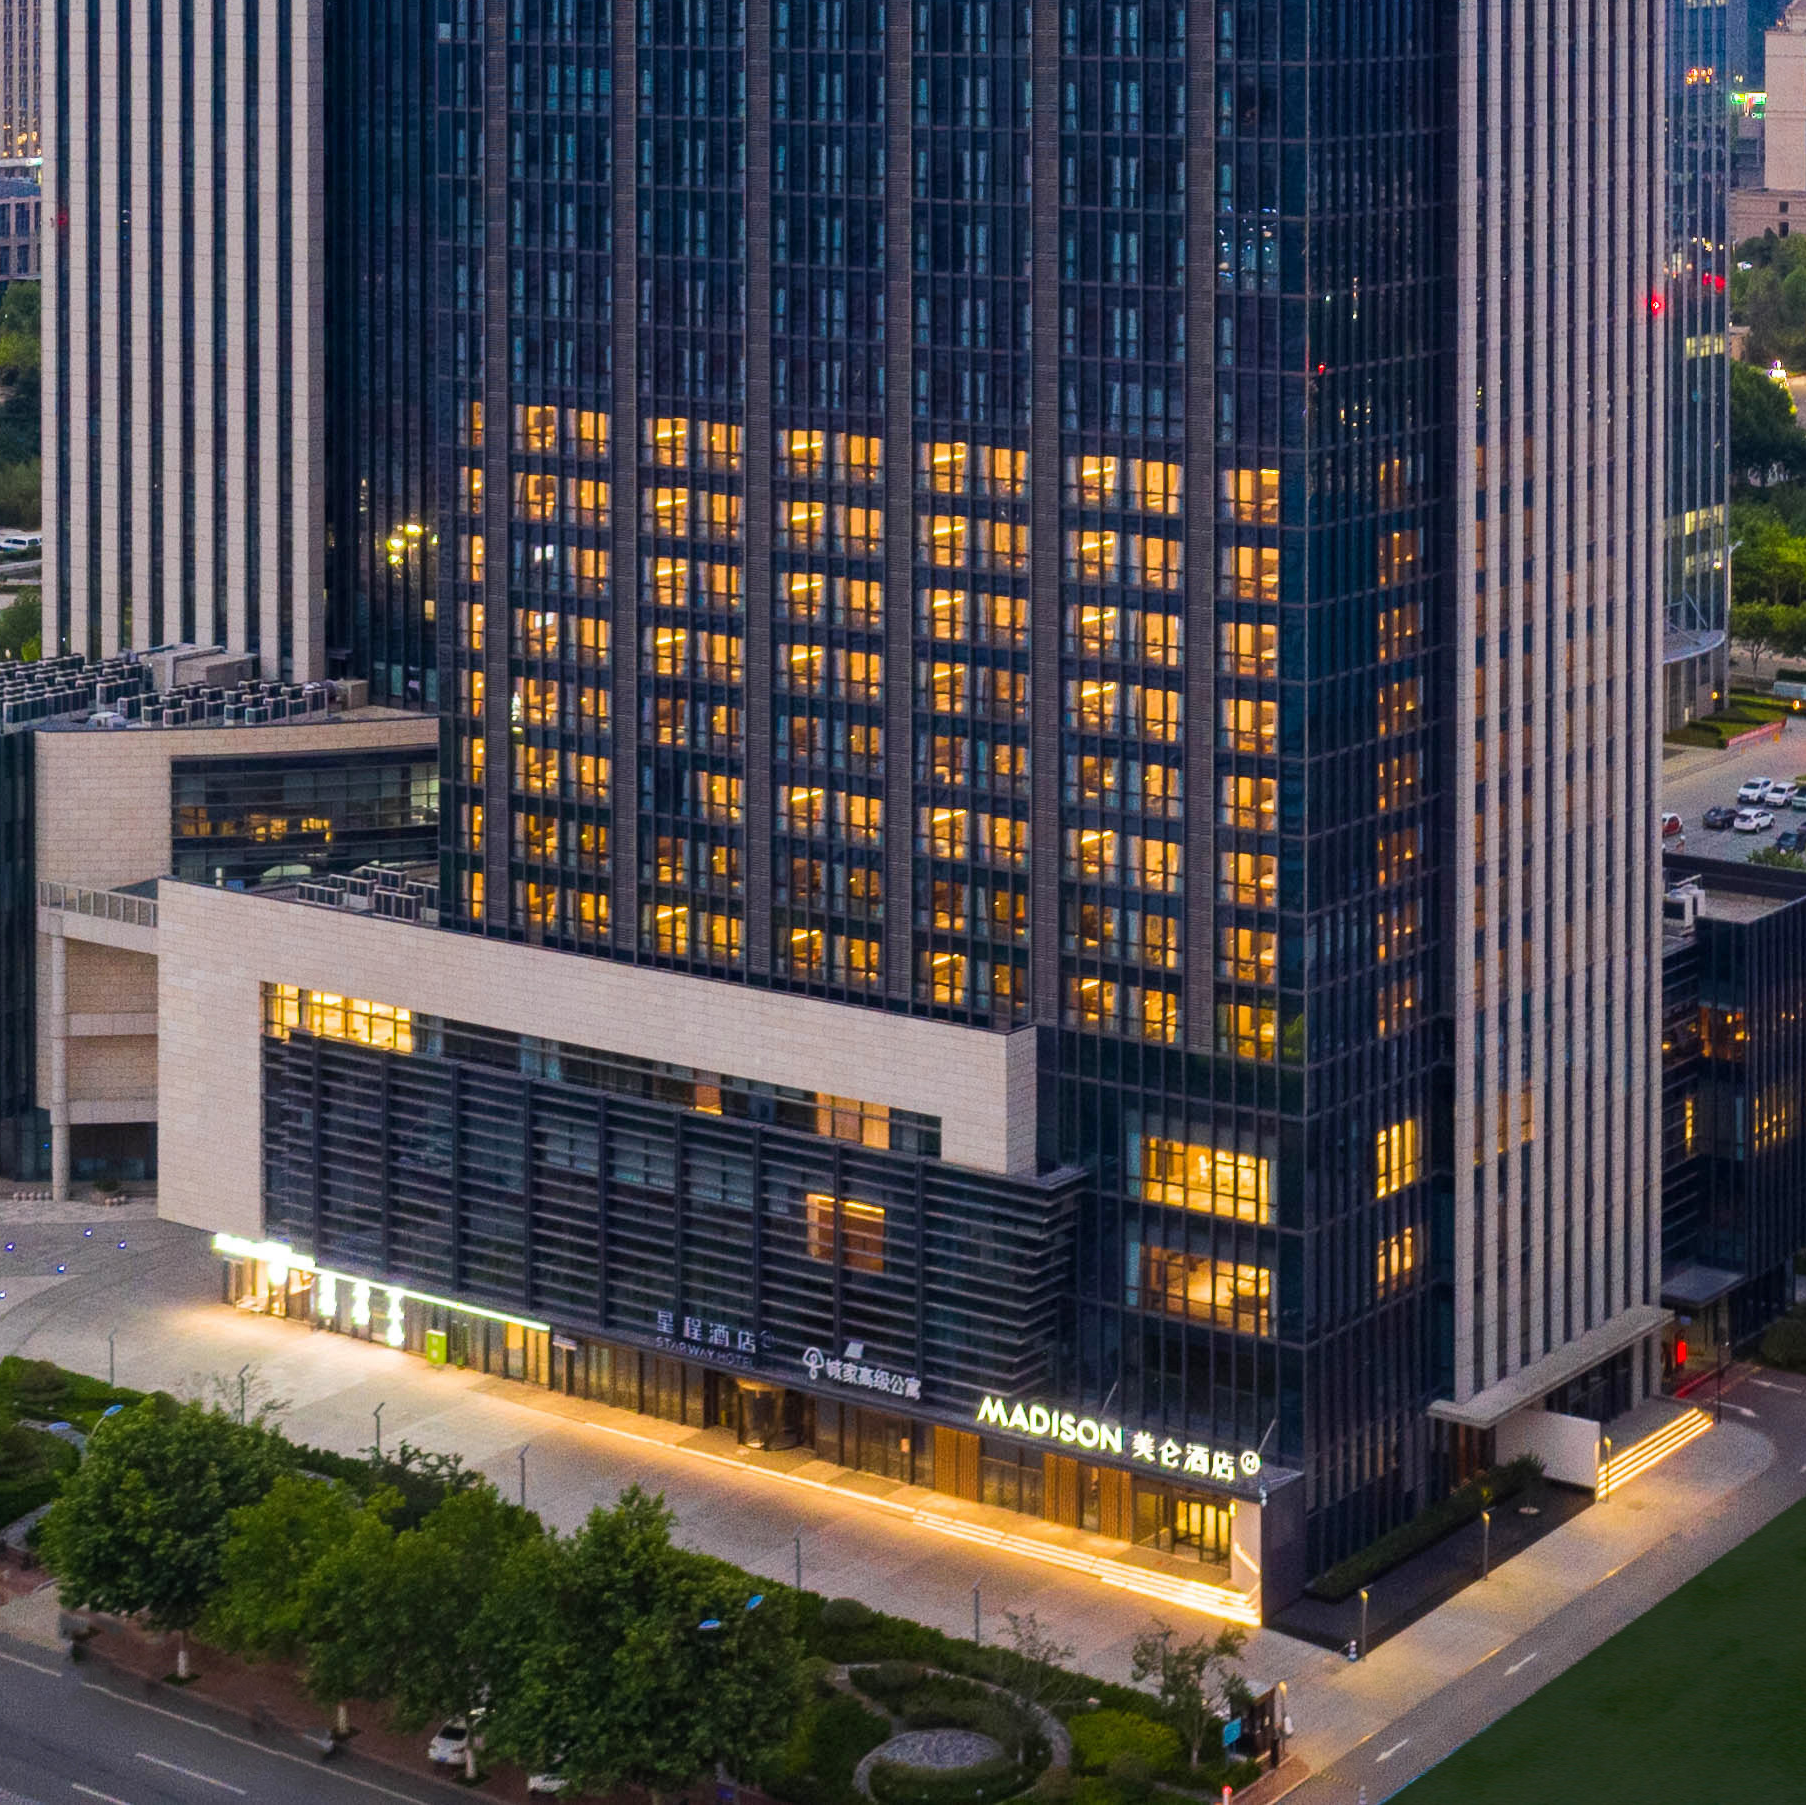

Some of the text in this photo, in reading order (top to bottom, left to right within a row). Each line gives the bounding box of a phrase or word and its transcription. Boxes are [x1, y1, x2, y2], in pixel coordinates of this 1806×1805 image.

[656, 1309, 756, 1354] 星程酒店
[977, 1395, 1123, 1453] MADISON
[1132, 1430, 1235, 1482] 美仑酒店
